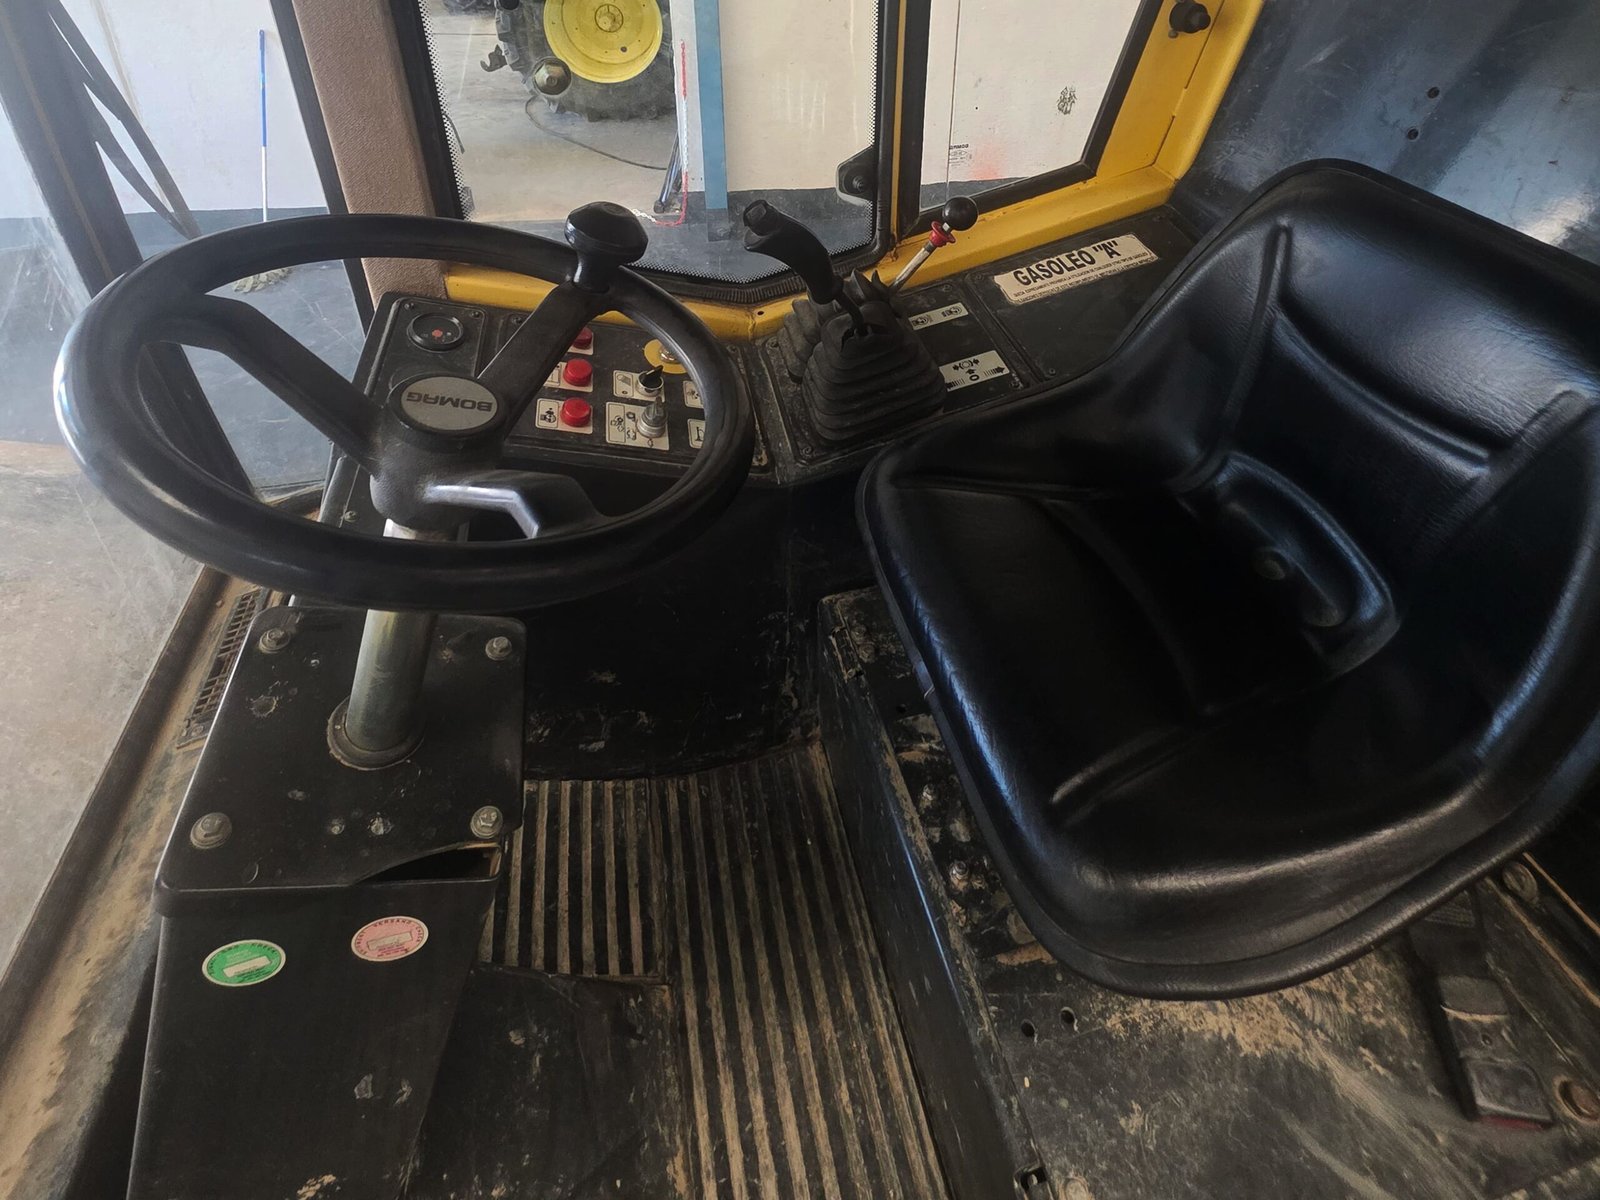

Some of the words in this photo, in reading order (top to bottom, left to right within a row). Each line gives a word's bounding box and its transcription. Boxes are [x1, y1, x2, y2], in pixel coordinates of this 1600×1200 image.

[1013, 249, 1096, 286] GASOLEO
[1093, 240, 1121, 259] "A"
[406, 391, 493, 412] BOMAG
